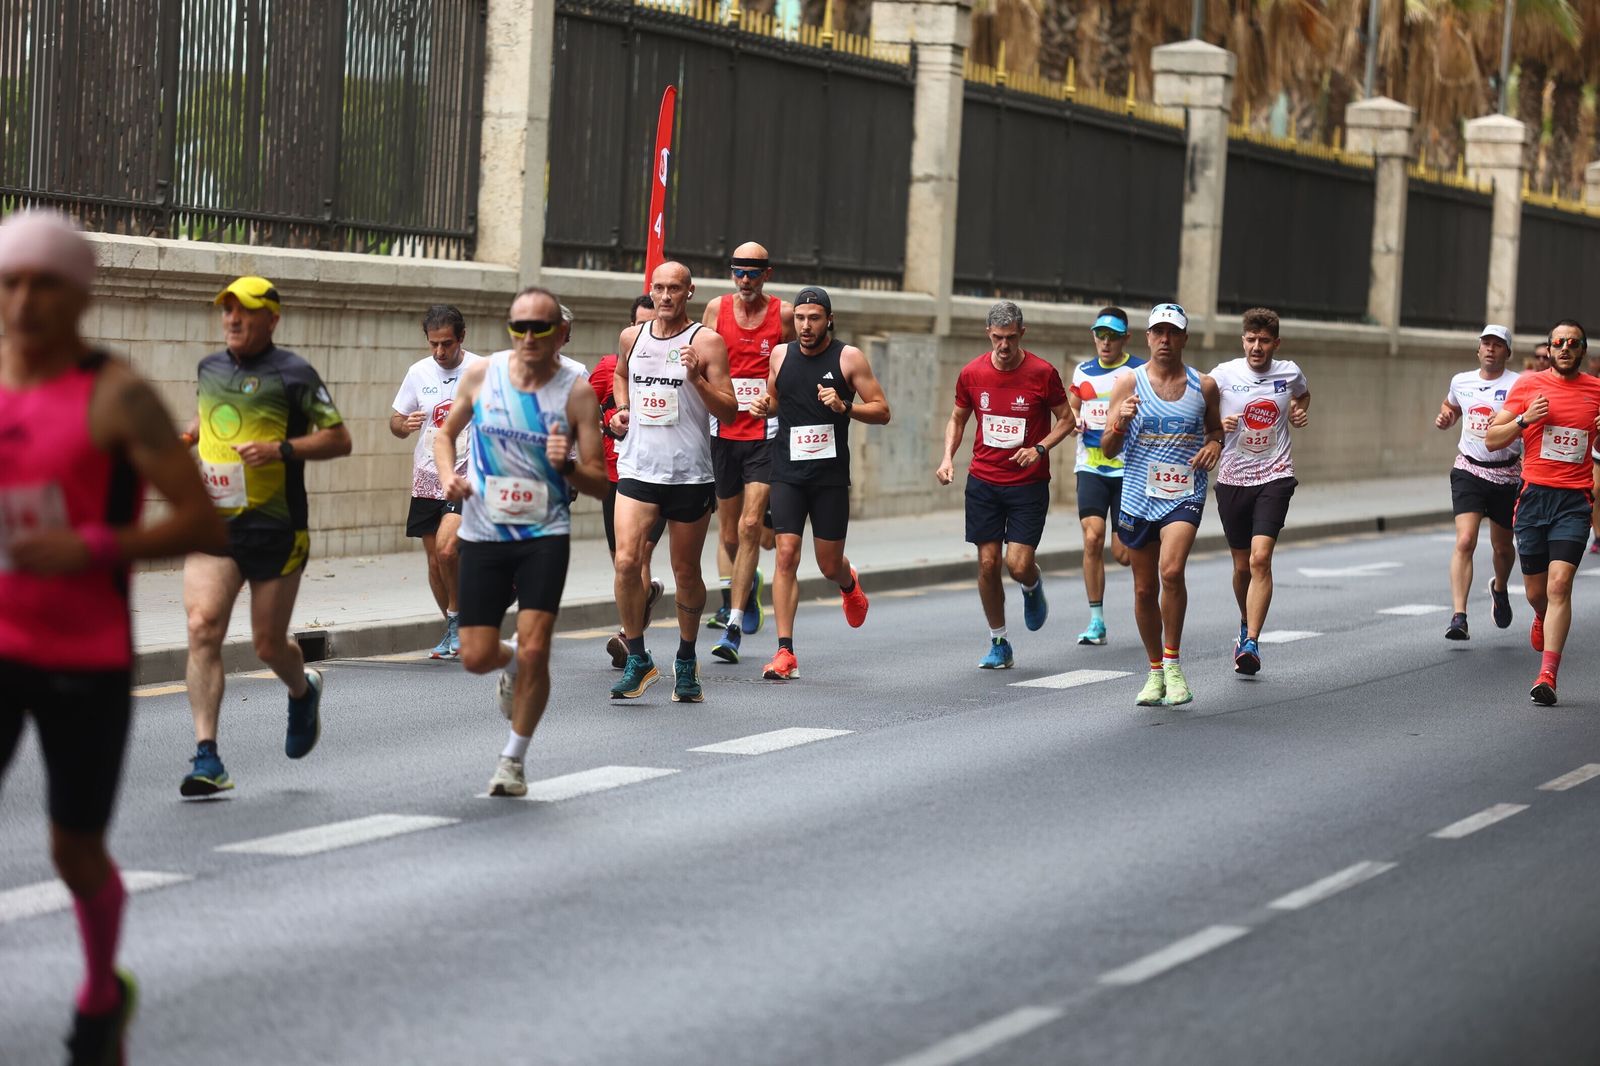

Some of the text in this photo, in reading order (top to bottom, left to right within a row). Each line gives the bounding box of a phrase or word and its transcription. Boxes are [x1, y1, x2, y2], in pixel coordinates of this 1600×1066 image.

[737, 387, 760, 395] 259
[643, 397, 666, 408] 789
[1250, 406, 1276, 418] PONLE
[1247, 413, 1273, 424] FRENO
[989, 423, 1019, 434] 1258
[797, 433, 828, 444] 1322
[1246, 436, 1269, 445] 327
[1553, 435, 1578, 446] 873
[1155, 472, 1188, 484] 1342
[500, 488, 533, 502] 769
